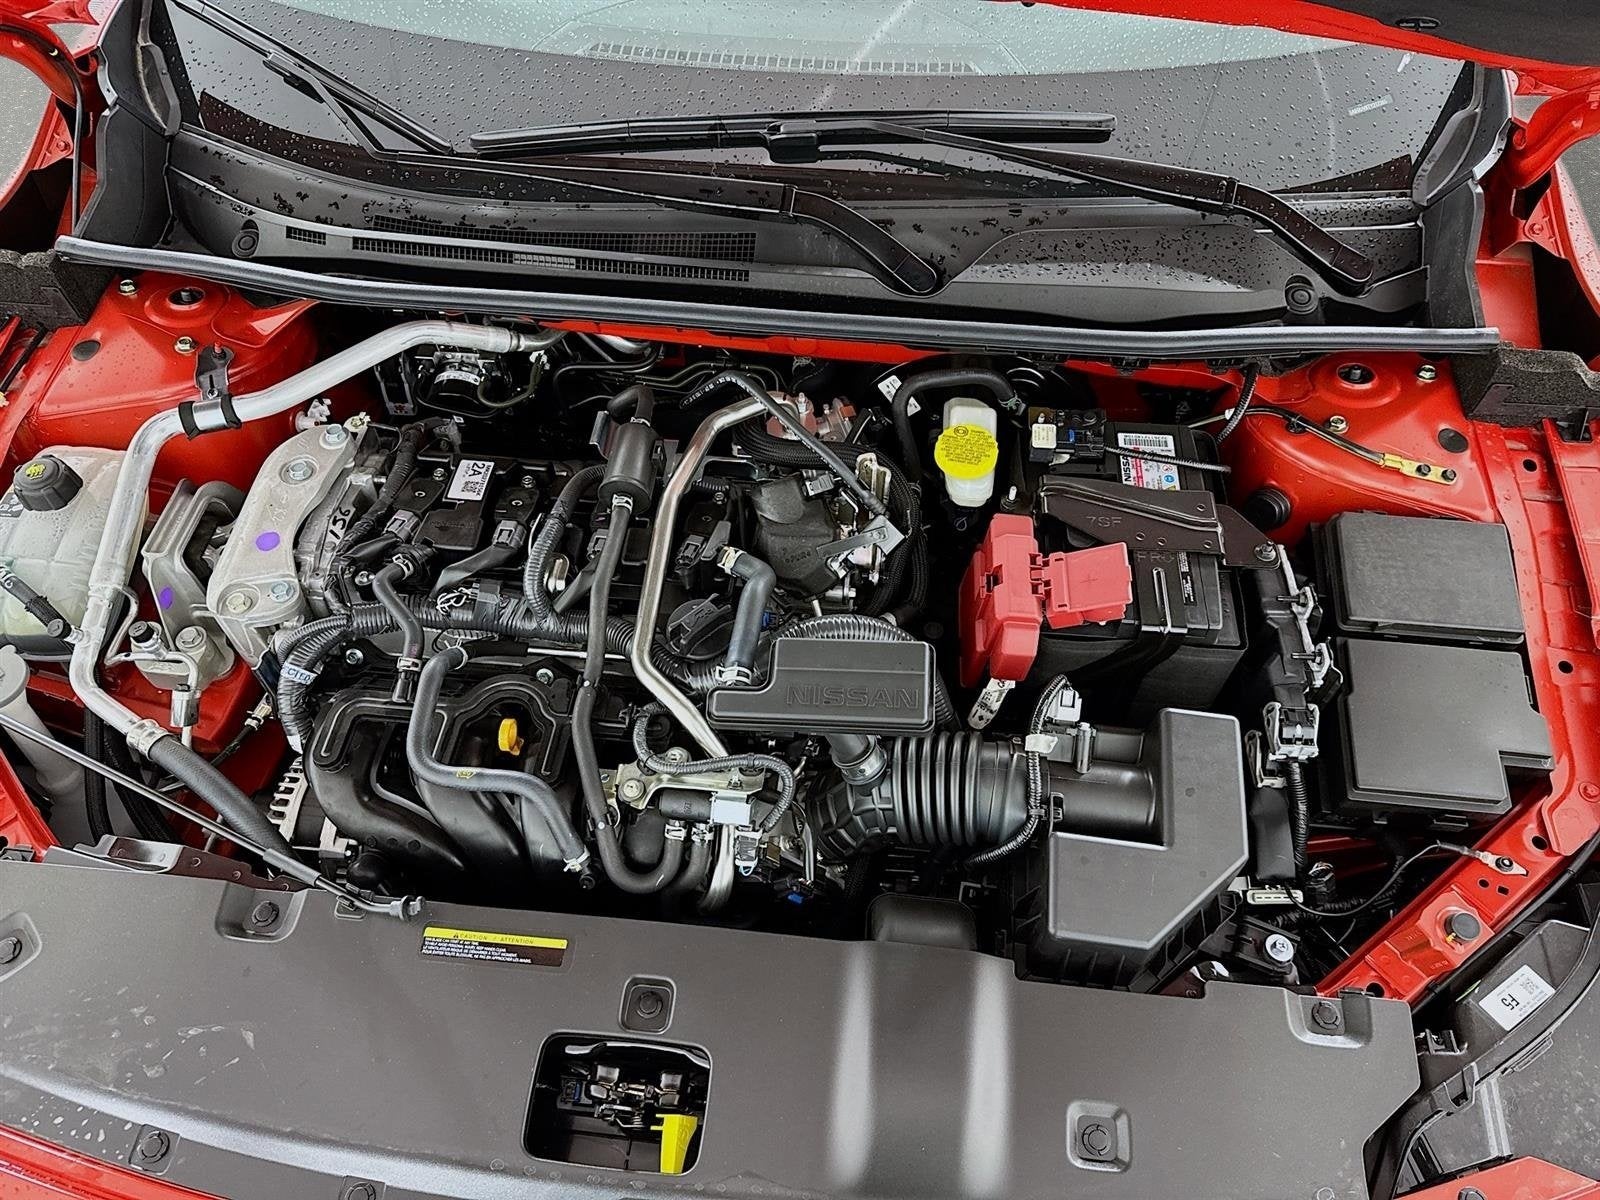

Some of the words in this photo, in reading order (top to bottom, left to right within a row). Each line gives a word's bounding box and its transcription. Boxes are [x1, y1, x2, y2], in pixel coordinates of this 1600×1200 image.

[468, 462, 486, 477] 2A
[1122, 455, 1132, 482] NISSA
[329, 506, 351, 540] 156
[785, 684, 920, 709] NISSAN
[460, 933, 487, 941] CAUTION
[500, 936, 534, 945] ATTENTION
[1500, 993, 1520, 1011] F5
